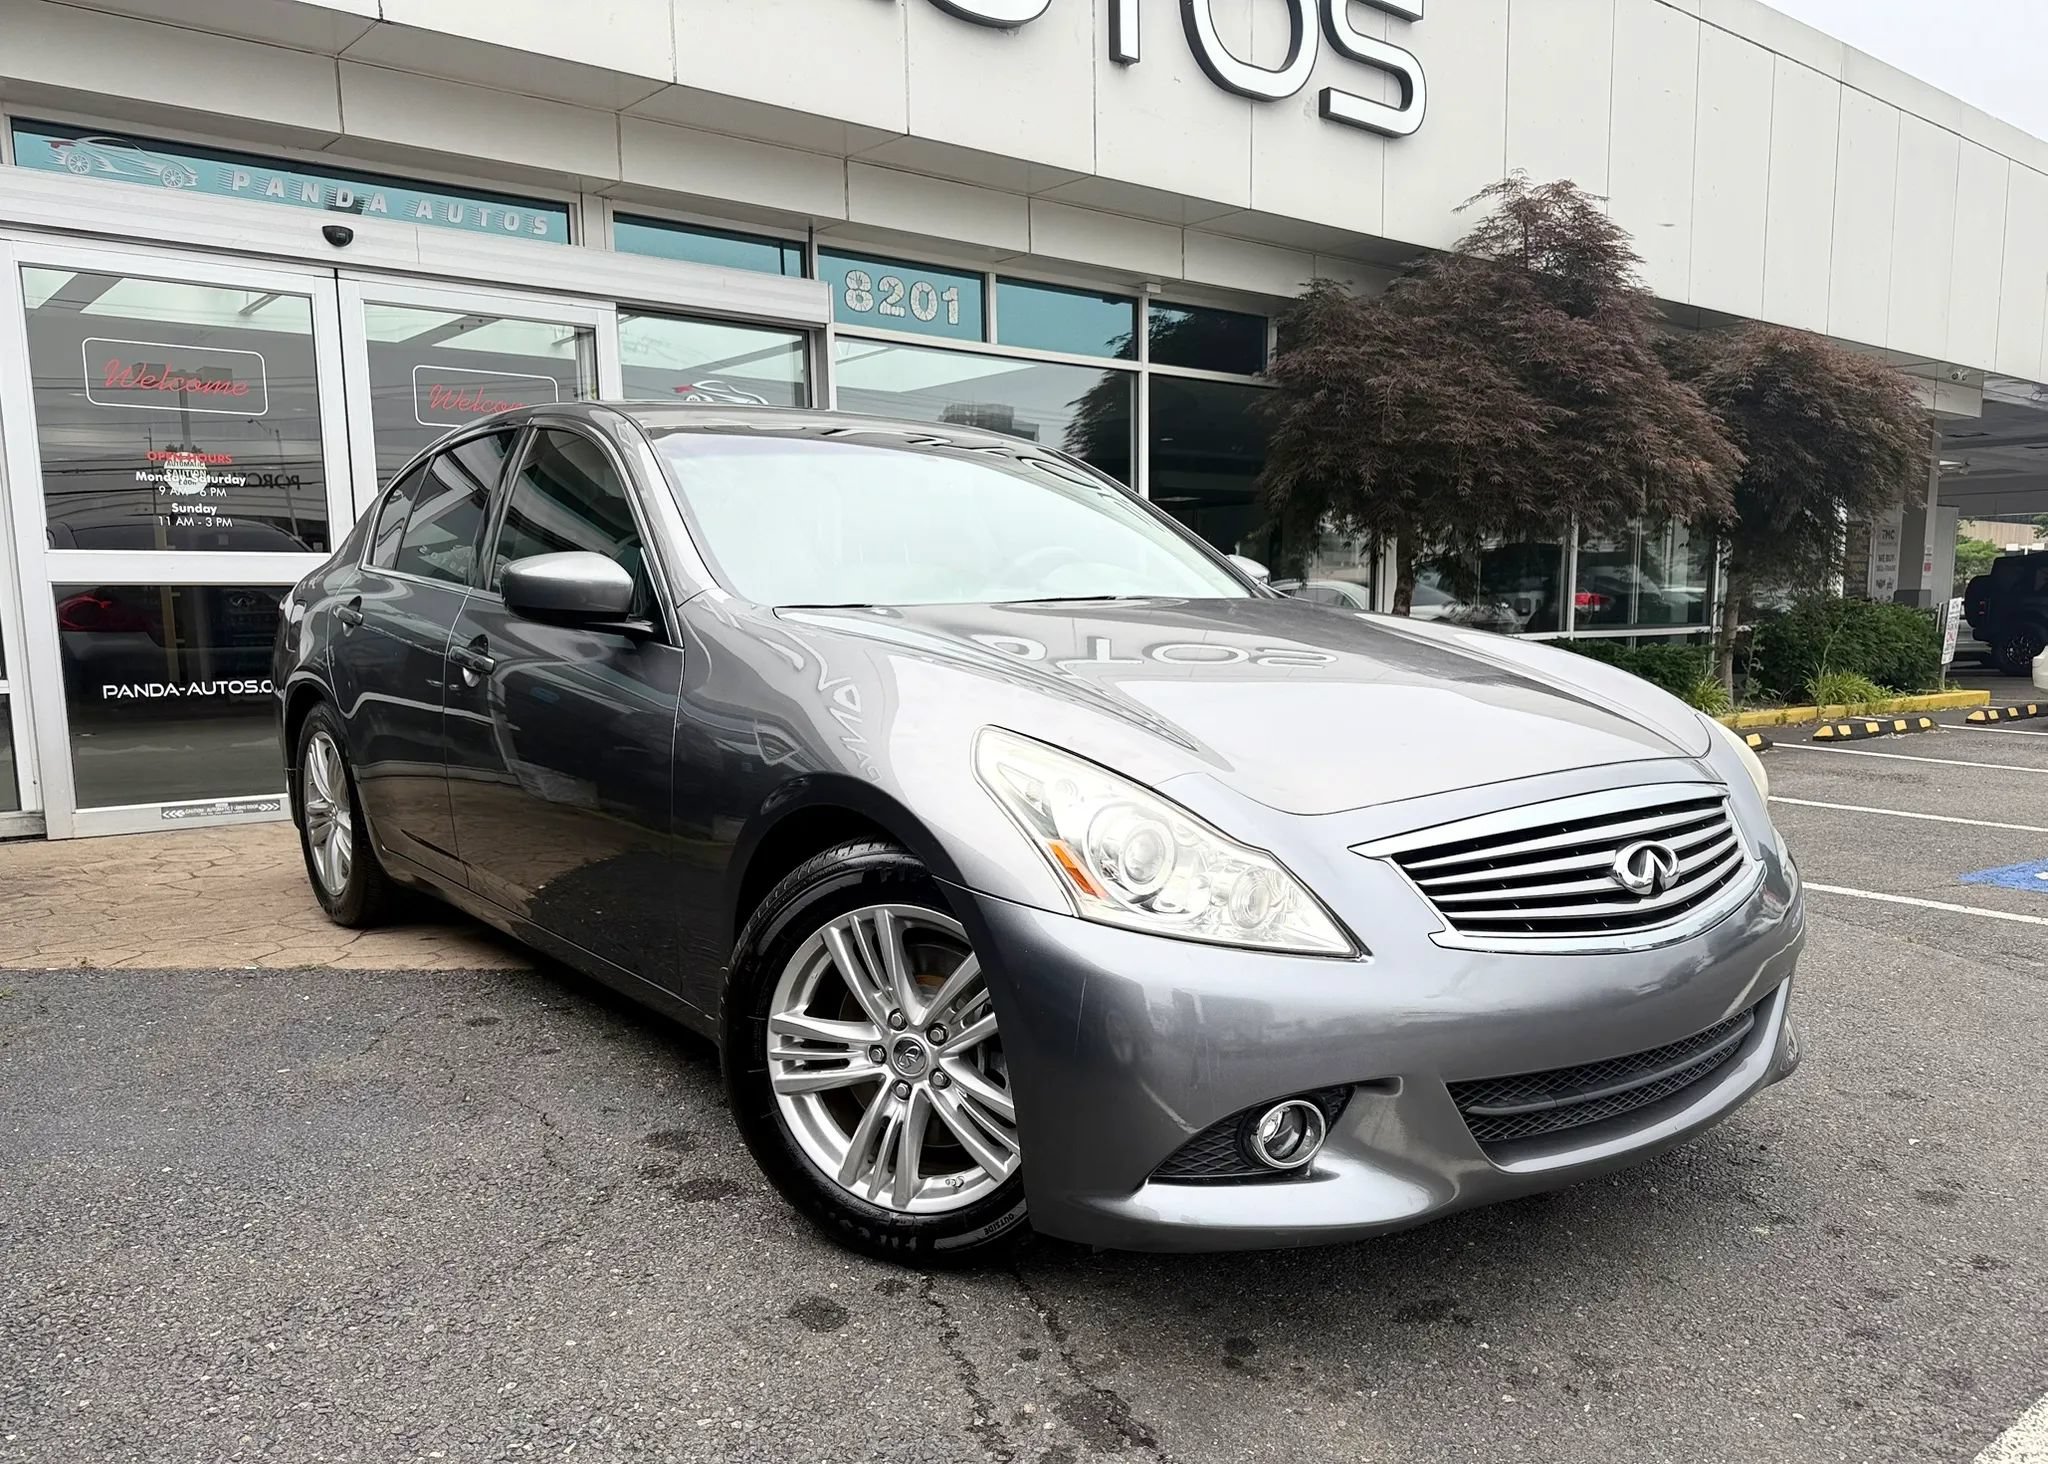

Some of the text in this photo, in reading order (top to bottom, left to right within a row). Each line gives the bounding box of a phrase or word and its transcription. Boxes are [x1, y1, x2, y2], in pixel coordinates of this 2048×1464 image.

[230, 169, 549, 236] PANDA AUTOS
[844, 269, 960, 326] 8201
[104, 358, 251, 397] Welcome
[146, 450, 233, 465] OPEN HOURS
[158, 485, 227, 498] 9 AM 6 PM
[171, 502, 218, 516] Sunday
[158, 516, 171, 527] 11
[175, 516, 195, 527] AM
[205, 516, 213, 528] 3
[216, 517, 233, 529] PM
[983, 1212, 1015, 1236] OUTSIDE
